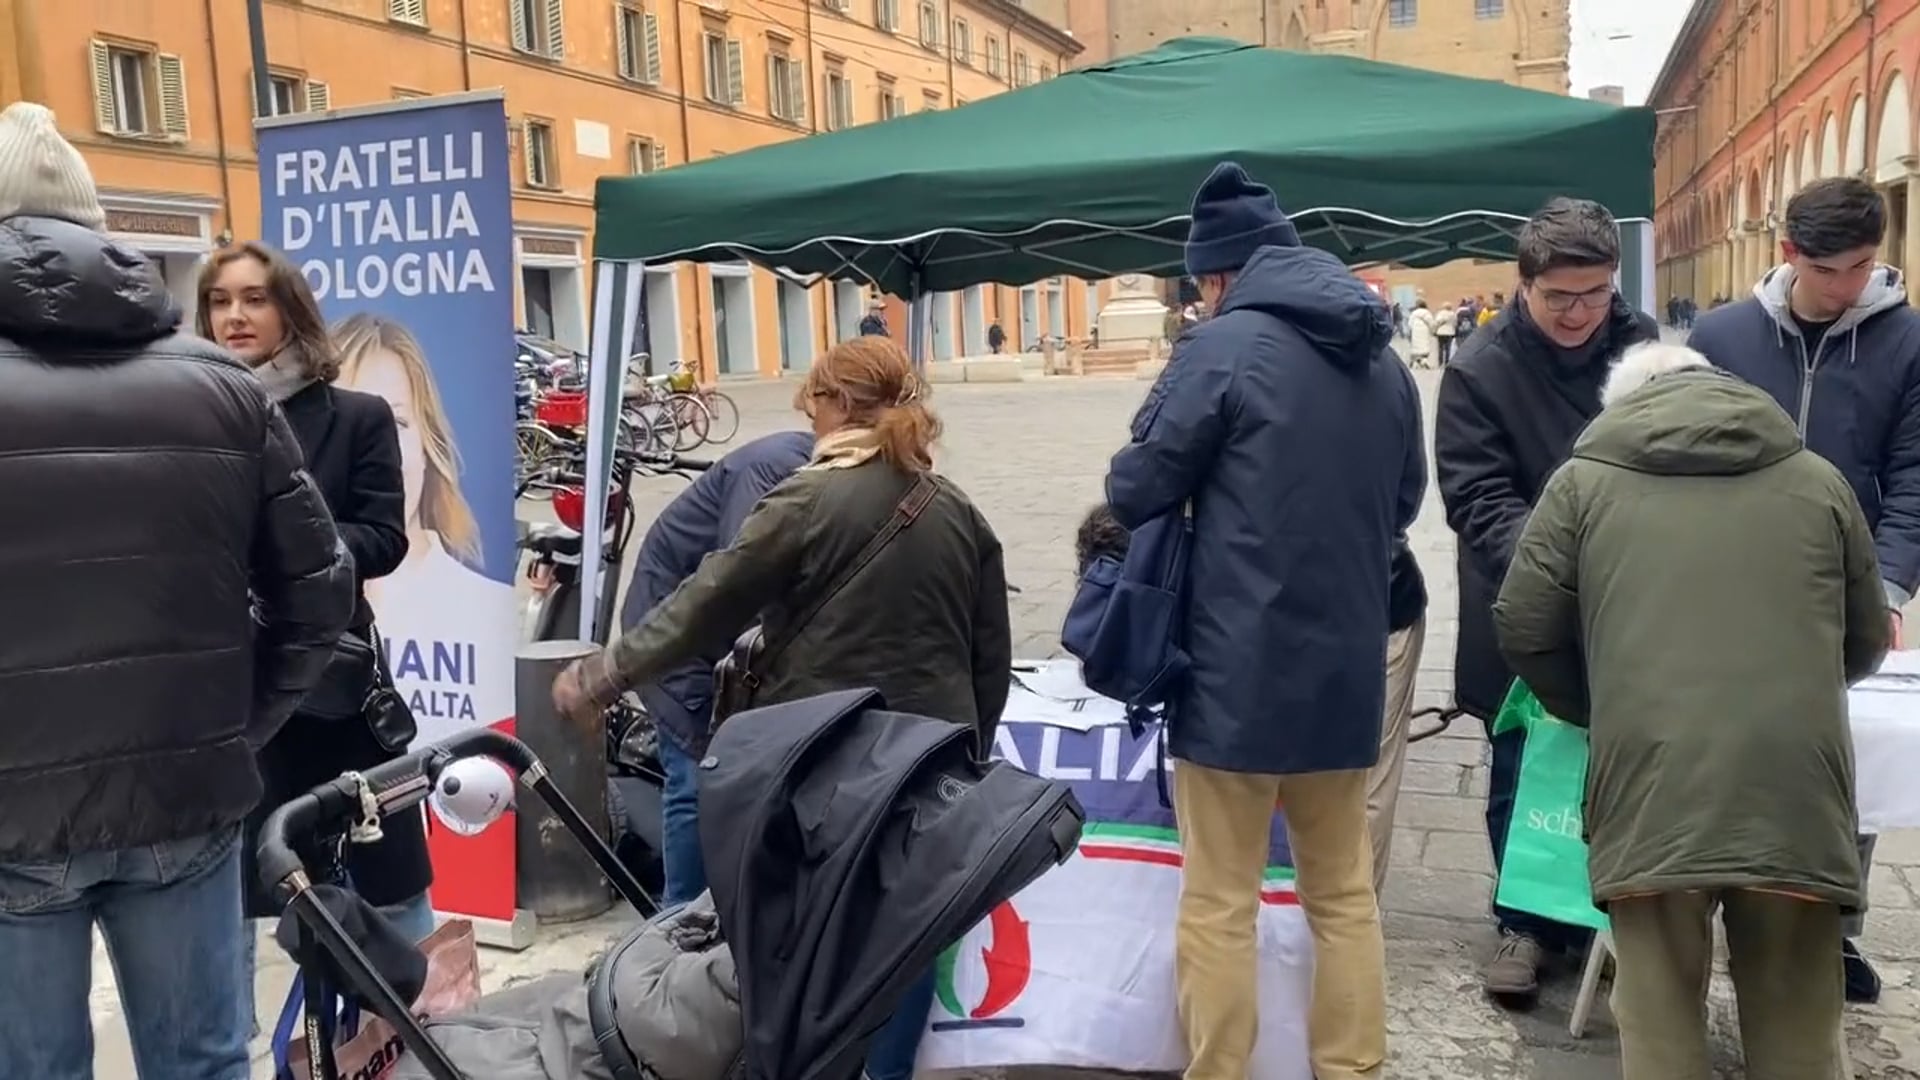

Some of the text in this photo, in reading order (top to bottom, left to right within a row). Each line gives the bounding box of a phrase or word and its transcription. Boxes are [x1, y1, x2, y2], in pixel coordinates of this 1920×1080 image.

[276, 131, 483, 196] FRATELLI
[282, 190, 480, 250] D'ITALIA
[301, 248, 495, 300] OLOGNA
[409, 689, 476, 720] ALTA
